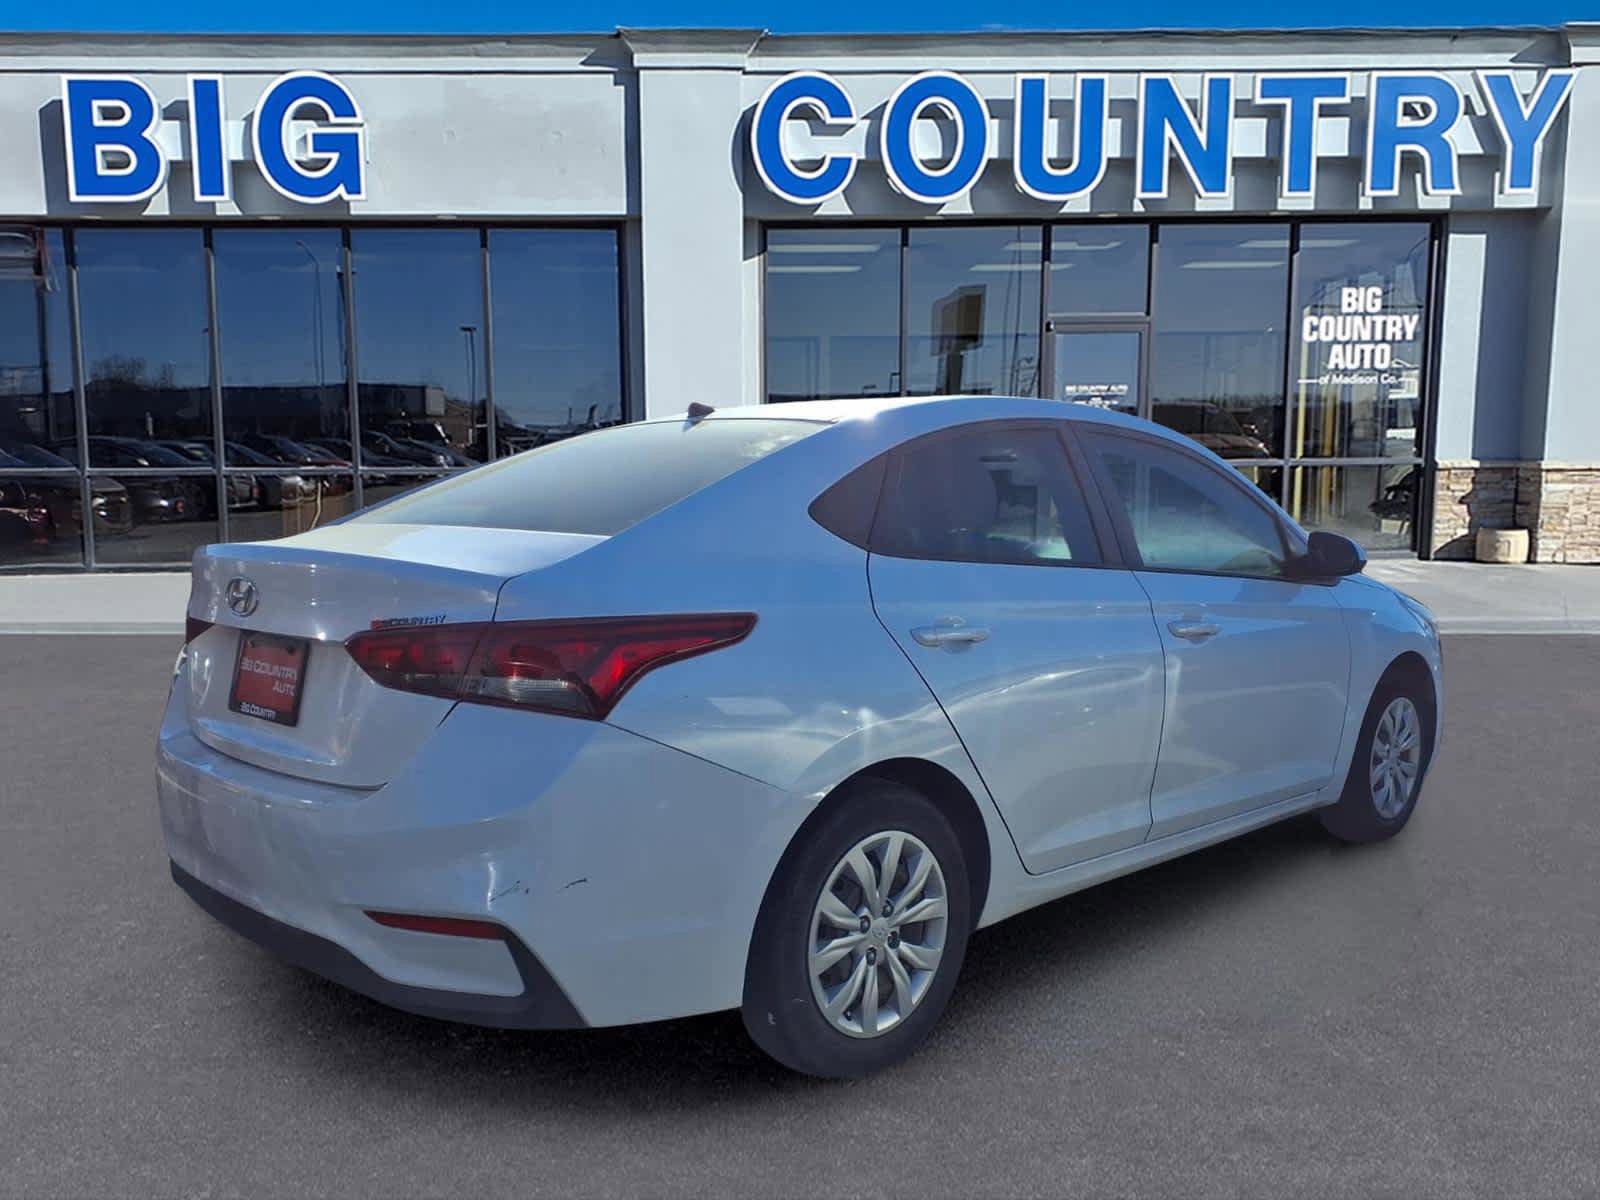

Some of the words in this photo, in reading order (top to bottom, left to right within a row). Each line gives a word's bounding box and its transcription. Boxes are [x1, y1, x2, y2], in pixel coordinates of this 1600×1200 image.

[60, 70, 367, 205] BIG
[750, 69, 1576, 206] COUNTRY
[1341, 286, 1383, 313] BIG
[1303, 314, 1419, 342] COUNTRY
[1328, 344, 1391, 370] AUTO
[1319, 374, 1329, 384] of
[1331, 374, 1378, 384] Madison
[1380, 373, 1398, 385] Co.
